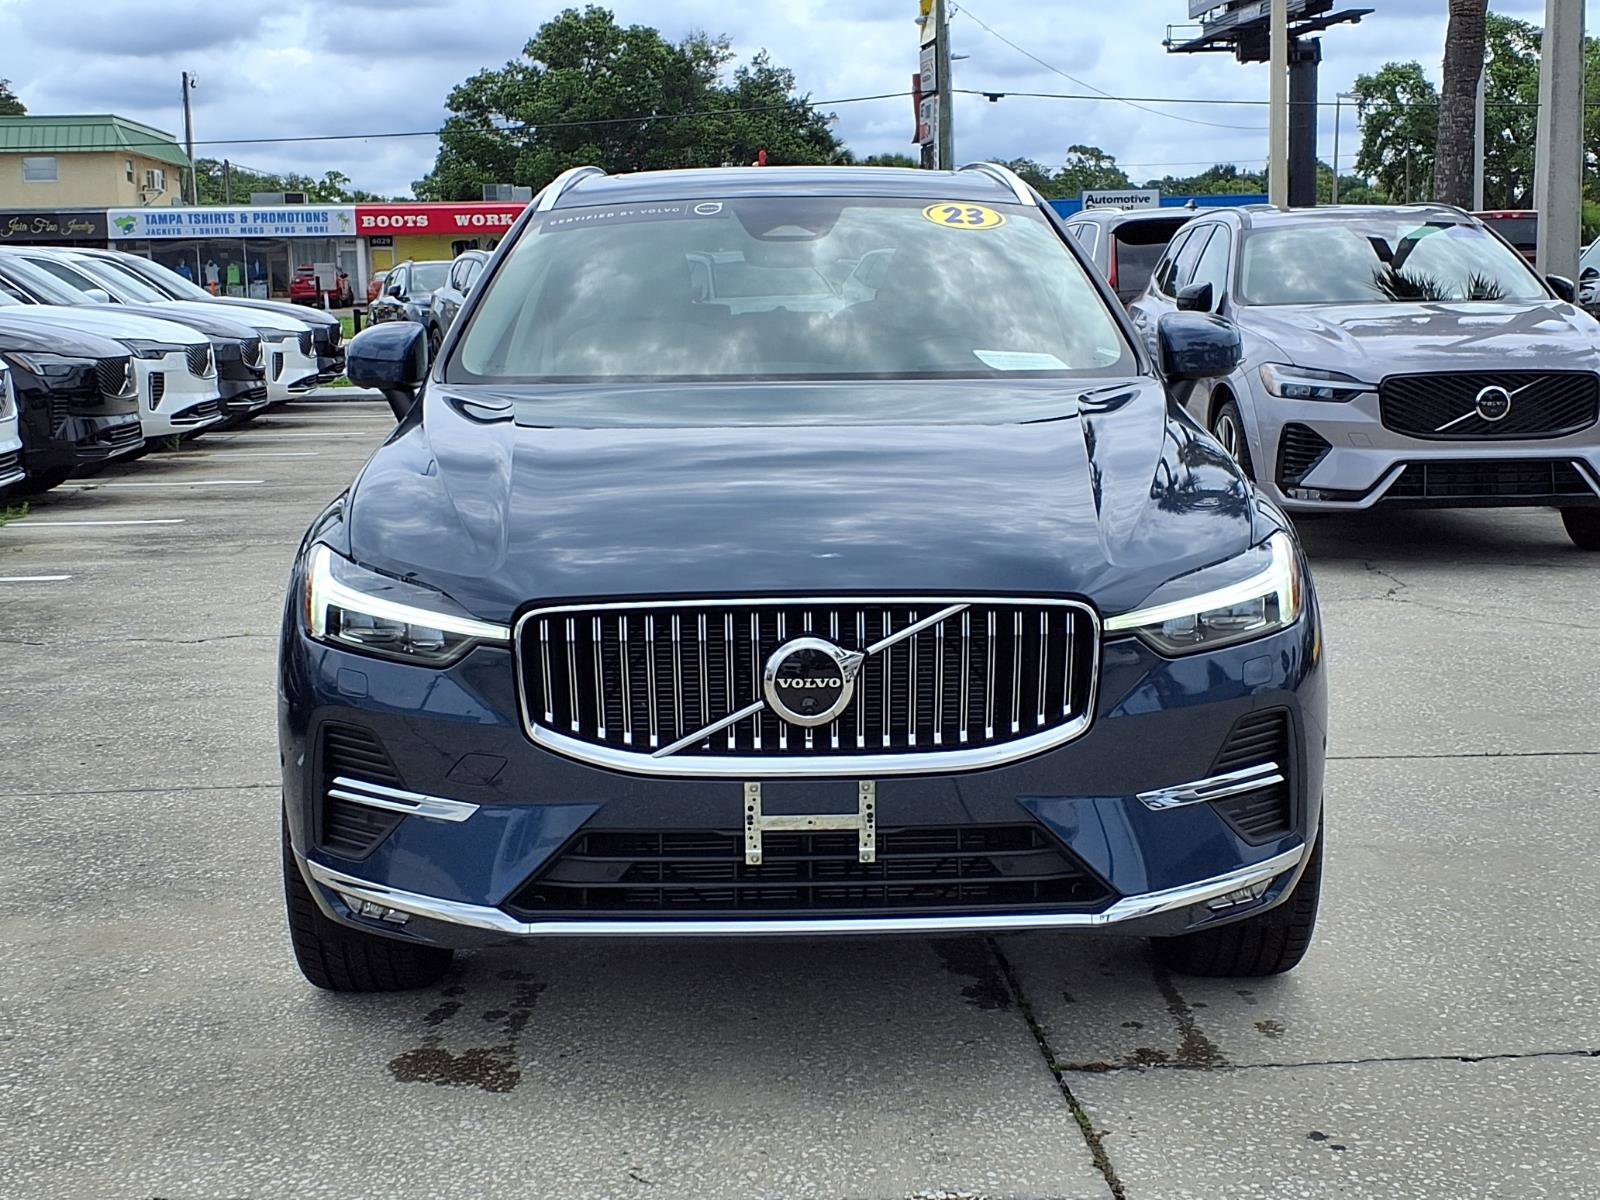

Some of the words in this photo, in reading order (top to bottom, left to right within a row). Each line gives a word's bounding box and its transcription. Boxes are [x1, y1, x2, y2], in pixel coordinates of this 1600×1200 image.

[1084, 194, 1151, 205] Automotive
[144, 213, 183, 225] TAMPA
[187, 212, 235, 225] TSHIRTS
[240, 212, 248, 224] &
[253, 211, 329, 223] PROMOTIONS
[361, 215, 429, 228] BOOTS
[454, 213, 514, 227] WORK
[550, 212, 614, 225] CERTIFIED
[942, 206, 985, 225] 23
[145, 227, 182, 236] JACKETS
[240, 226, 265, 235] MUGS
[274, 225, 296, 234] PENS
[777, 678, 841, 689] VOLVO
